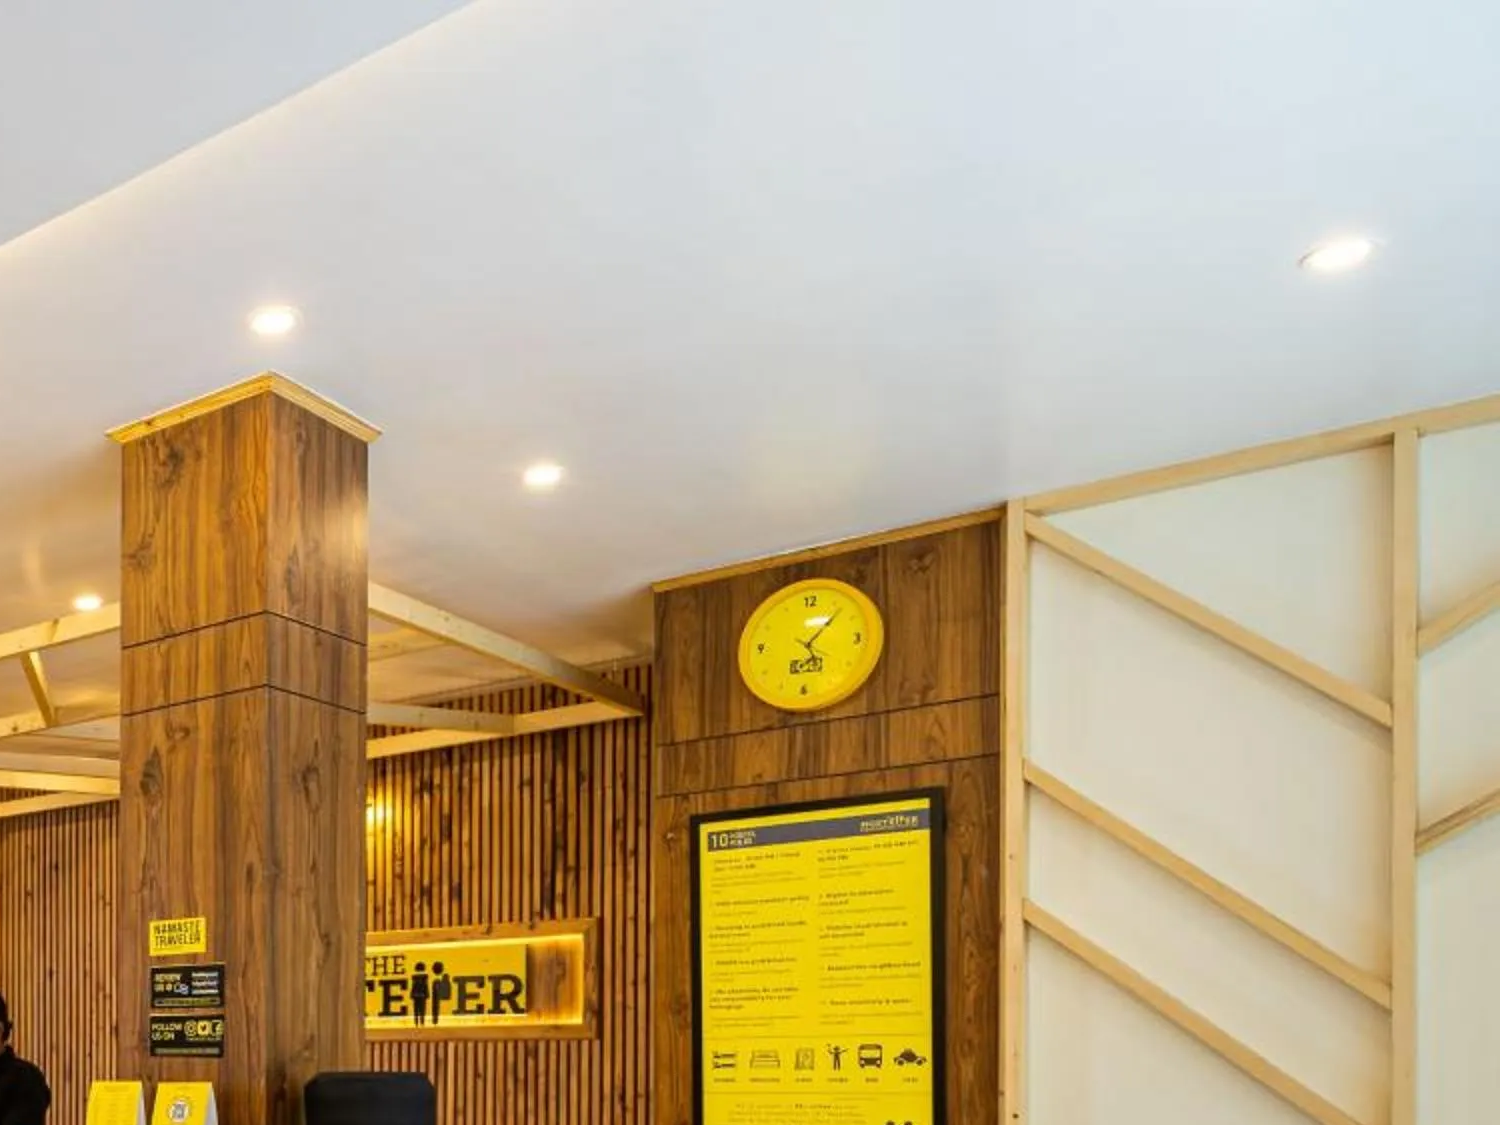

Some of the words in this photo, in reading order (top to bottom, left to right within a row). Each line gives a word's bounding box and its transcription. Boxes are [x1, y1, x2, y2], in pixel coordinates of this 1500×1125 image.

[804, 596, 817, 607] 12
[711, 833, 729, 848] 10
[153, 920, 201, 934] NAMASTE
